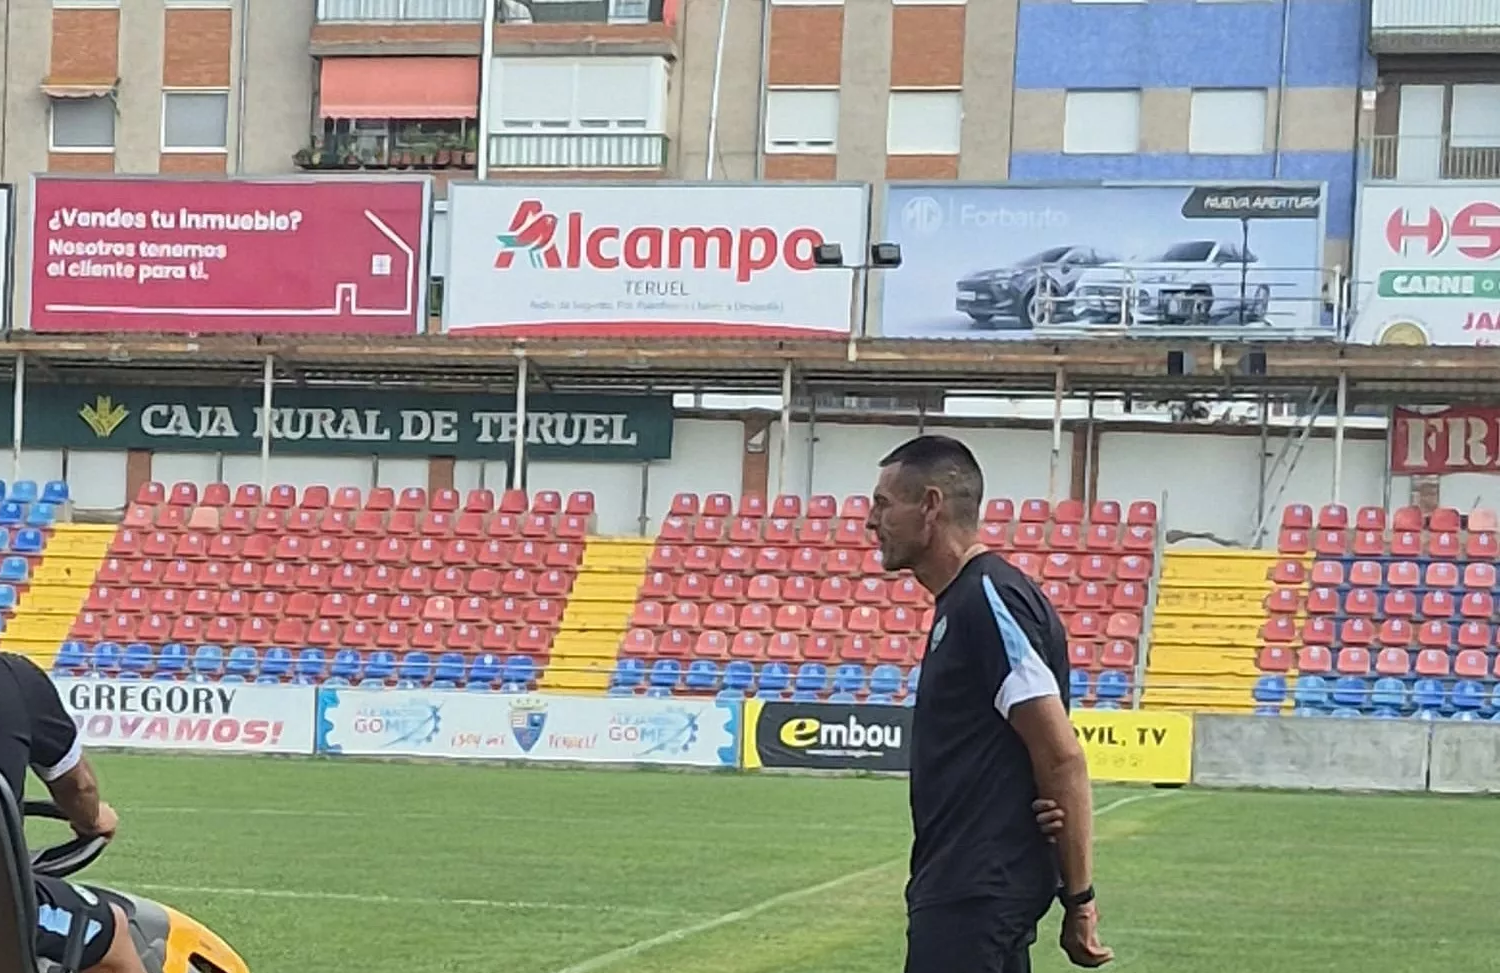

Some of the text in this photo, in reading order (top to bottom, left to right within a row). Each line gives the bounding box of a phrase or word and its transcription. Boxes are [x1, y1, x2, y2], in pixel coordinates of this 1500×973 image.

[1204, 195, 1250, 209] NUEVA
[48, 207, 146, 231] ¿Vendes
[151, 209, 175, 230] tu
[48, 239, 228, 259] Nosotros tenemos
[494, 199, 827, 283] Alcampo
[47, 260, 65, 277] el
[68, 260, 135, 279] cliente
[138, 265, 186, 284] para
[624, 280, 690, 296] TERUEL
[1392, 275, 1475, 294] CARNE
[1462, 312, 1500, 331] JA
[141, 404, 240, 439] CAJA
[252, 406, 391, 441] RURAL
[400, 410, 458, 443] DE
[70, 683, 237, 714] GREGORY
[780, 715, 902, 749] embou
[1136, 728, 1167, 746] TV
